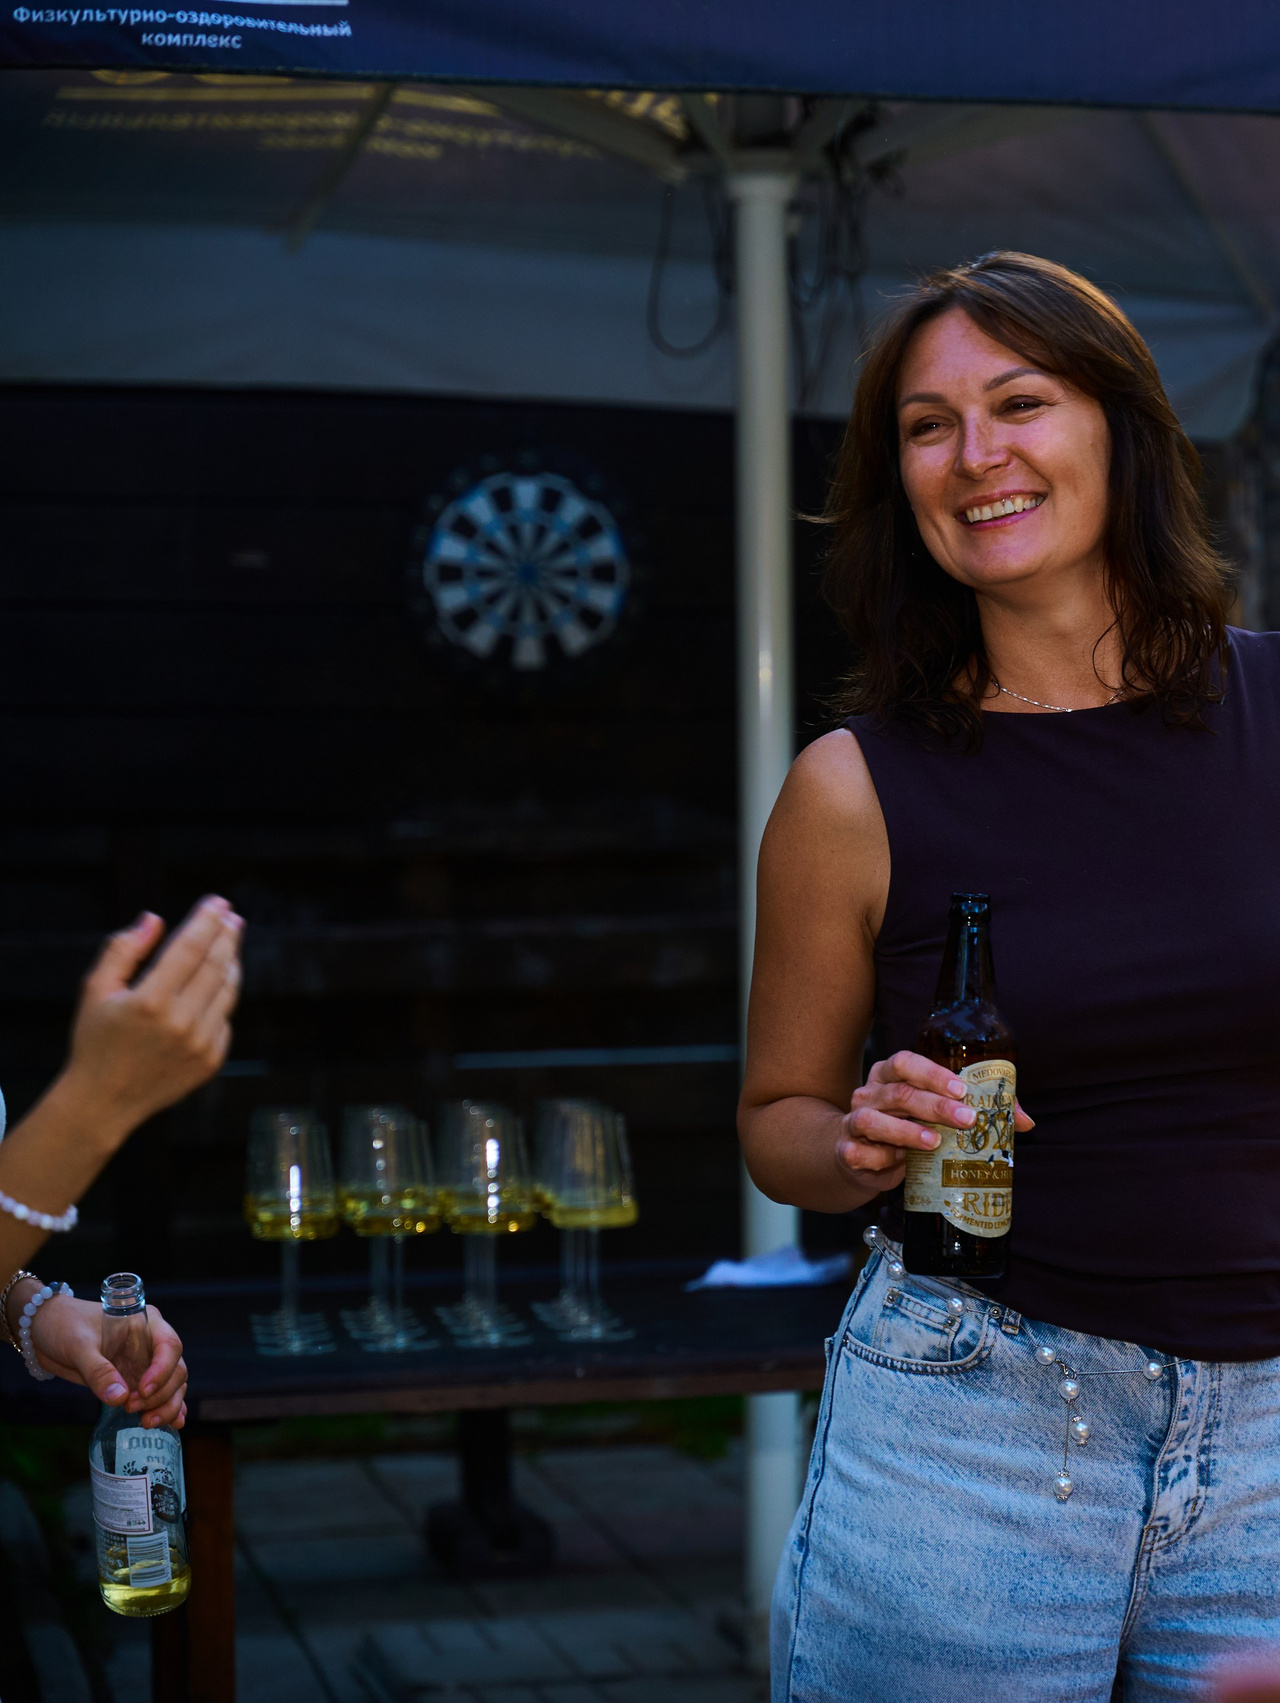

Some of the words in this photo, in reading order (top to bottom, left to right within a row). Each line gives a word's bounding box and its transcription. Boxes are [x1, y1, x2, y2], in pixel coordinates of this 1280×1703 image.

[12, 5, 353, 38] Физкультурно-оздоровительный
[141, 32, 243, 49] комплекс
[950, 1169, 991, 1180] HONEY
[991, 1169, 1000, 1180] &
